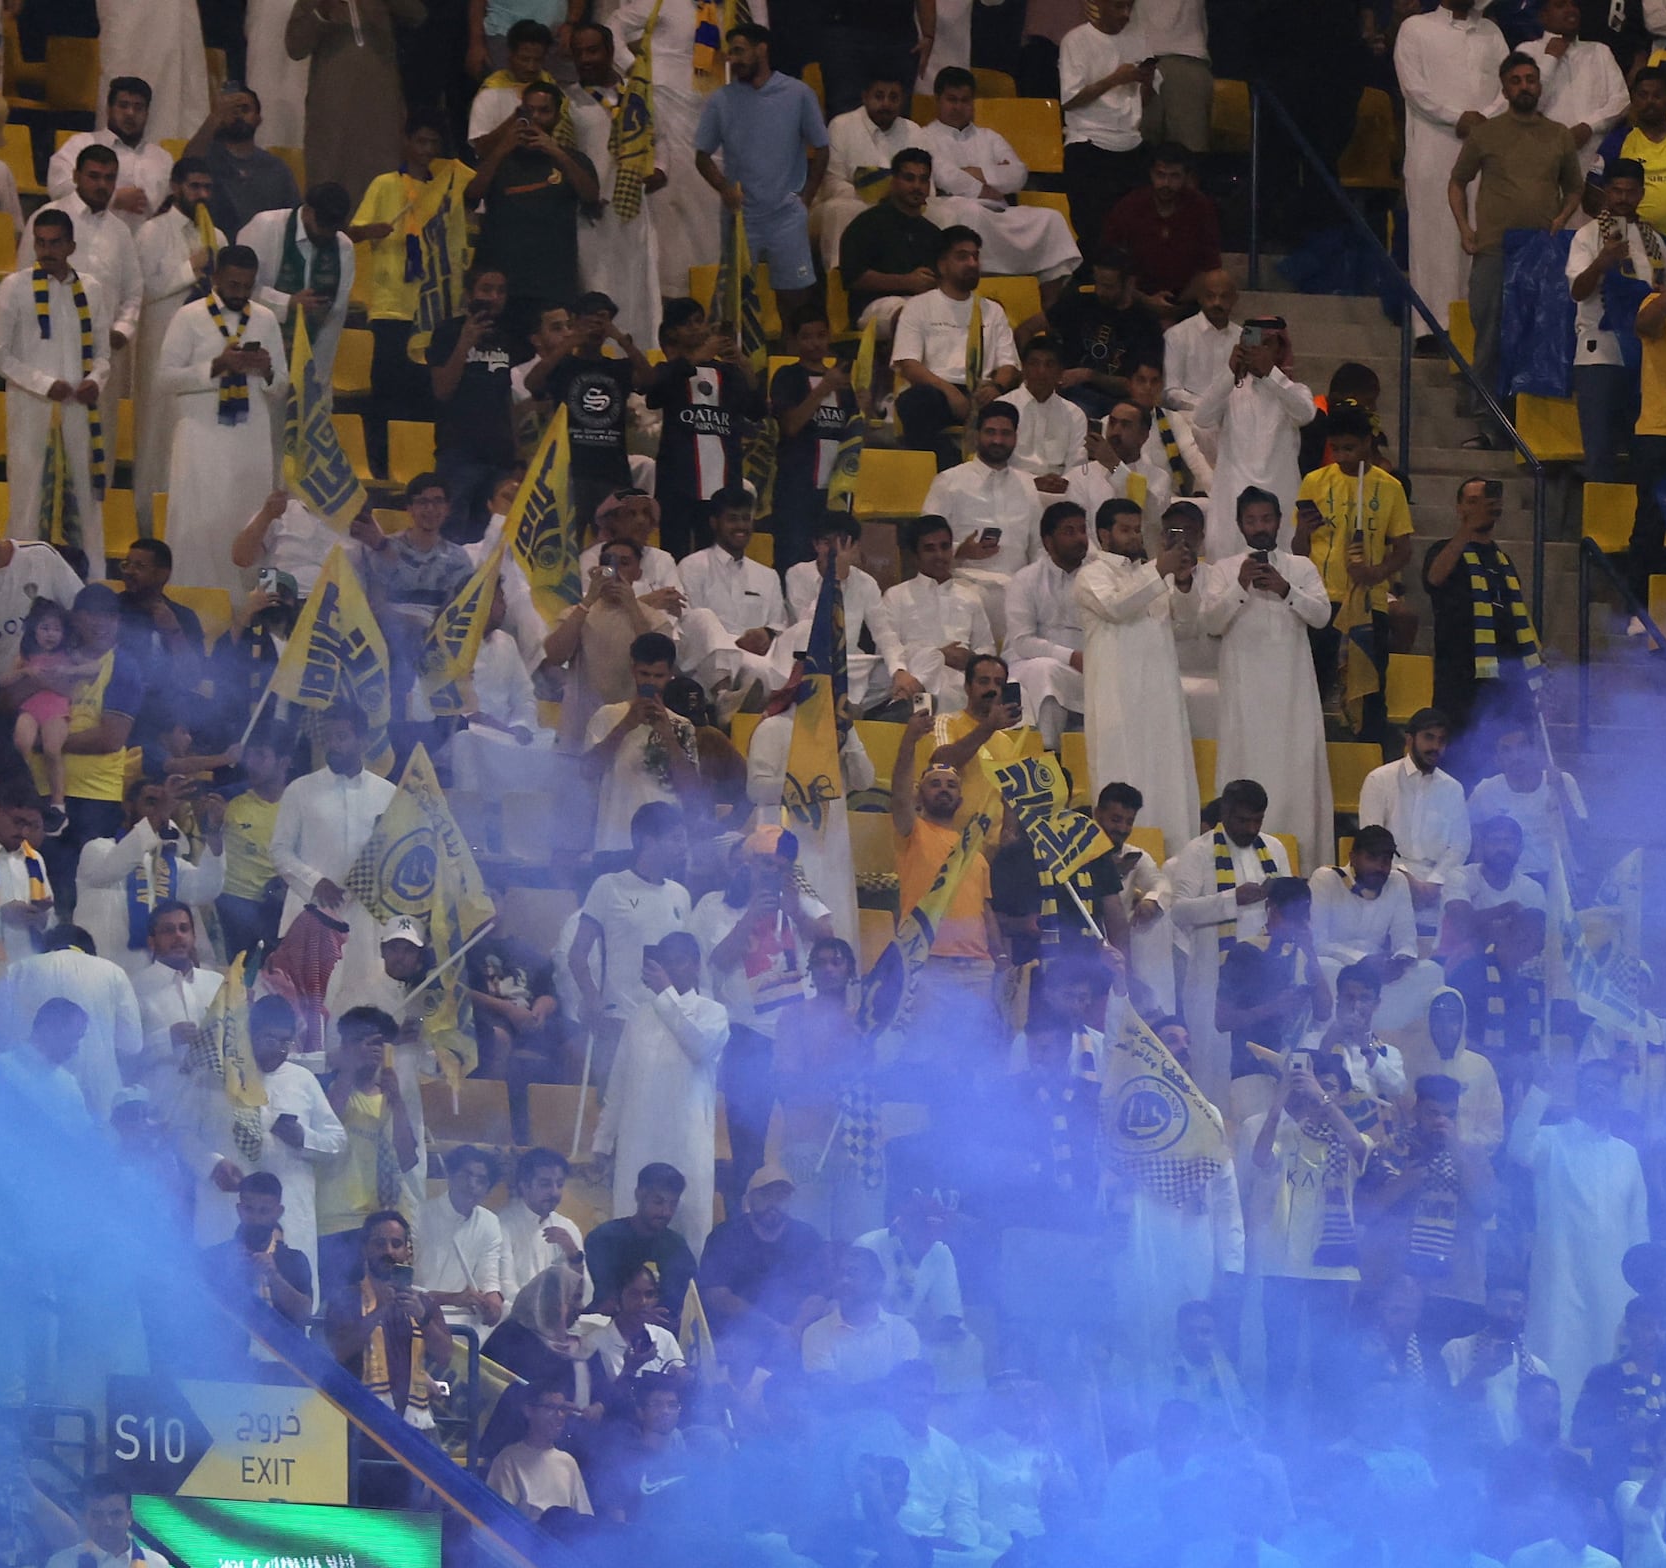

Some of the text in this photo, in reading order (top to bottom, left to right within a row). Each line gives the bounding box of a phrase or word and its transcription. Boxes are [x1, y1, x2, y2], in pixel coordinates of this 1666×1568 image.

[680, 408, 730, 426] QATAR
[114, 1413, 187, 1465] S10
[236, 1407, 302, 1445] خروج
[241, 1455, 296, 1486] EXIT
